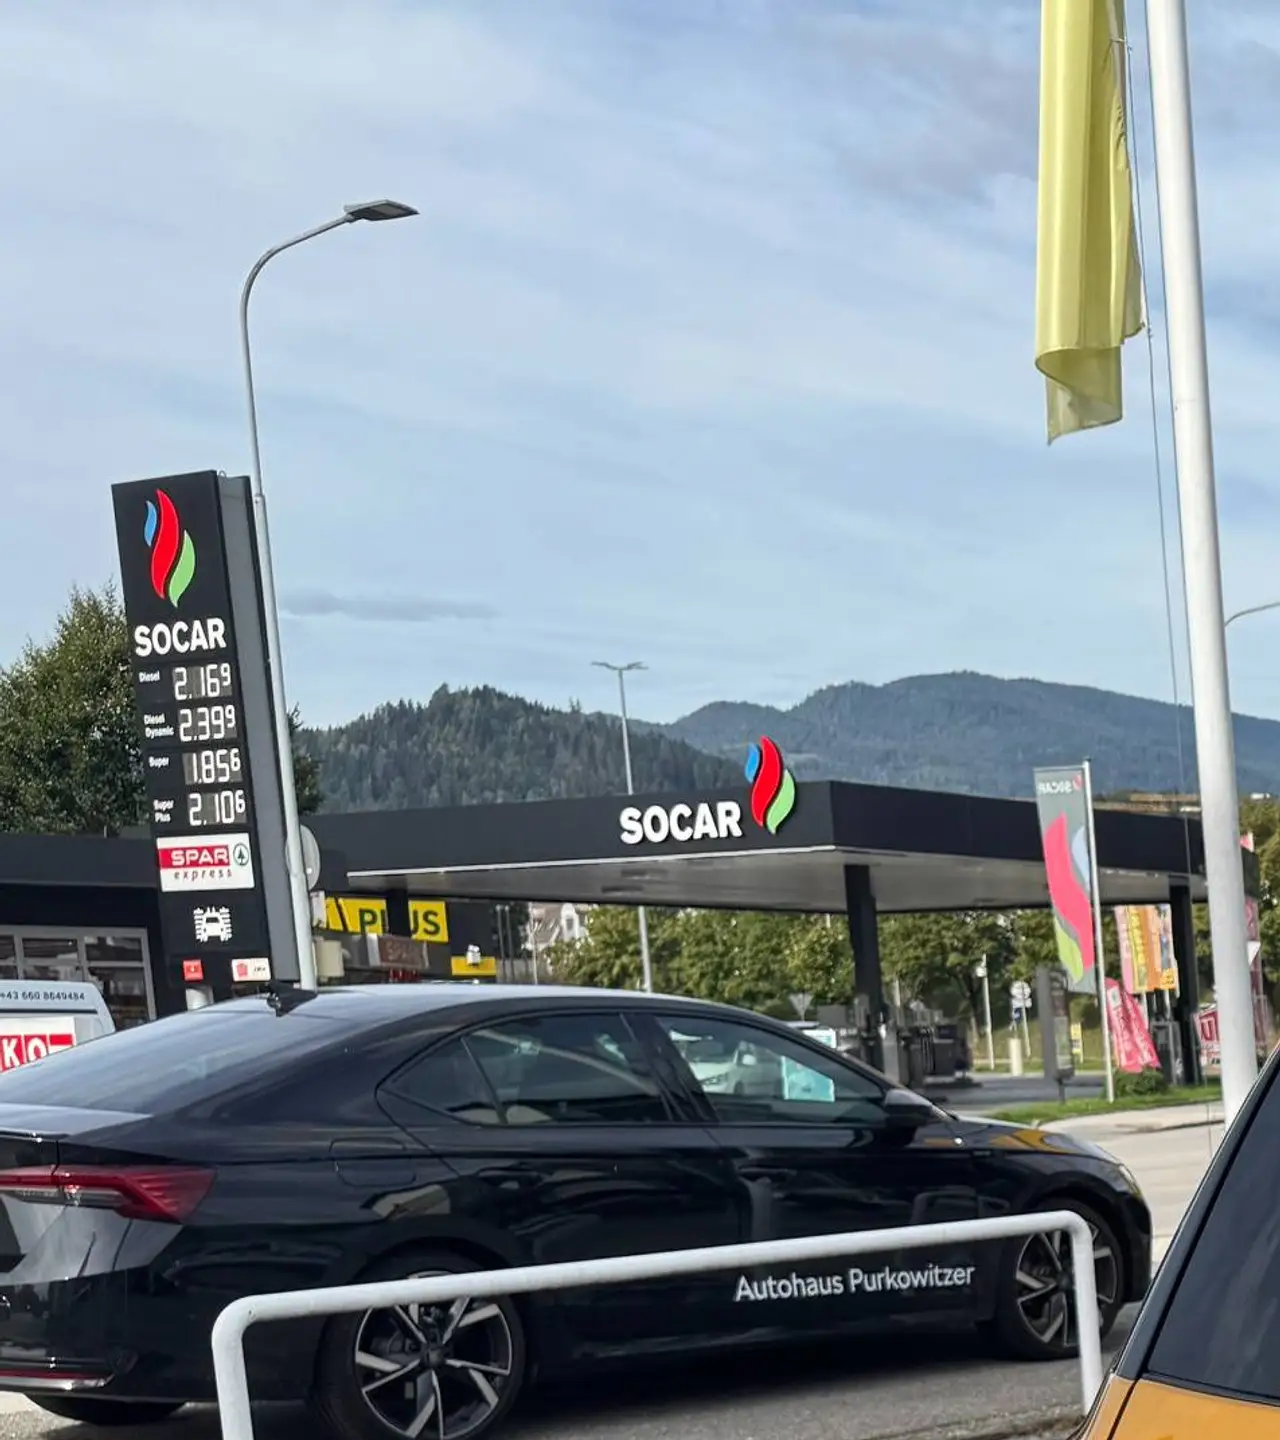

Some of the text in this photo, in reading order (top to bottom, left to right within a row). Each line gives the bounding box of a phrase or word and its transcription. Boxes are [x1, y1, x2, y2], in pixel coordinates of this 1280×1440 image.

[134, 617, 227, 657] SOCAR
[139, 663, 231, 700] Diesel 2.169
[179, 704, 236, 742] 2.399
[188, 789, 246, 826] 2.106
[619, 801, 743, 845] SOCAR
[171, 848, 229, 866] SPAR
[174, 868, 232, 882] express
[734, 1262, 975, 1302] Autohaus Purkowitzer
